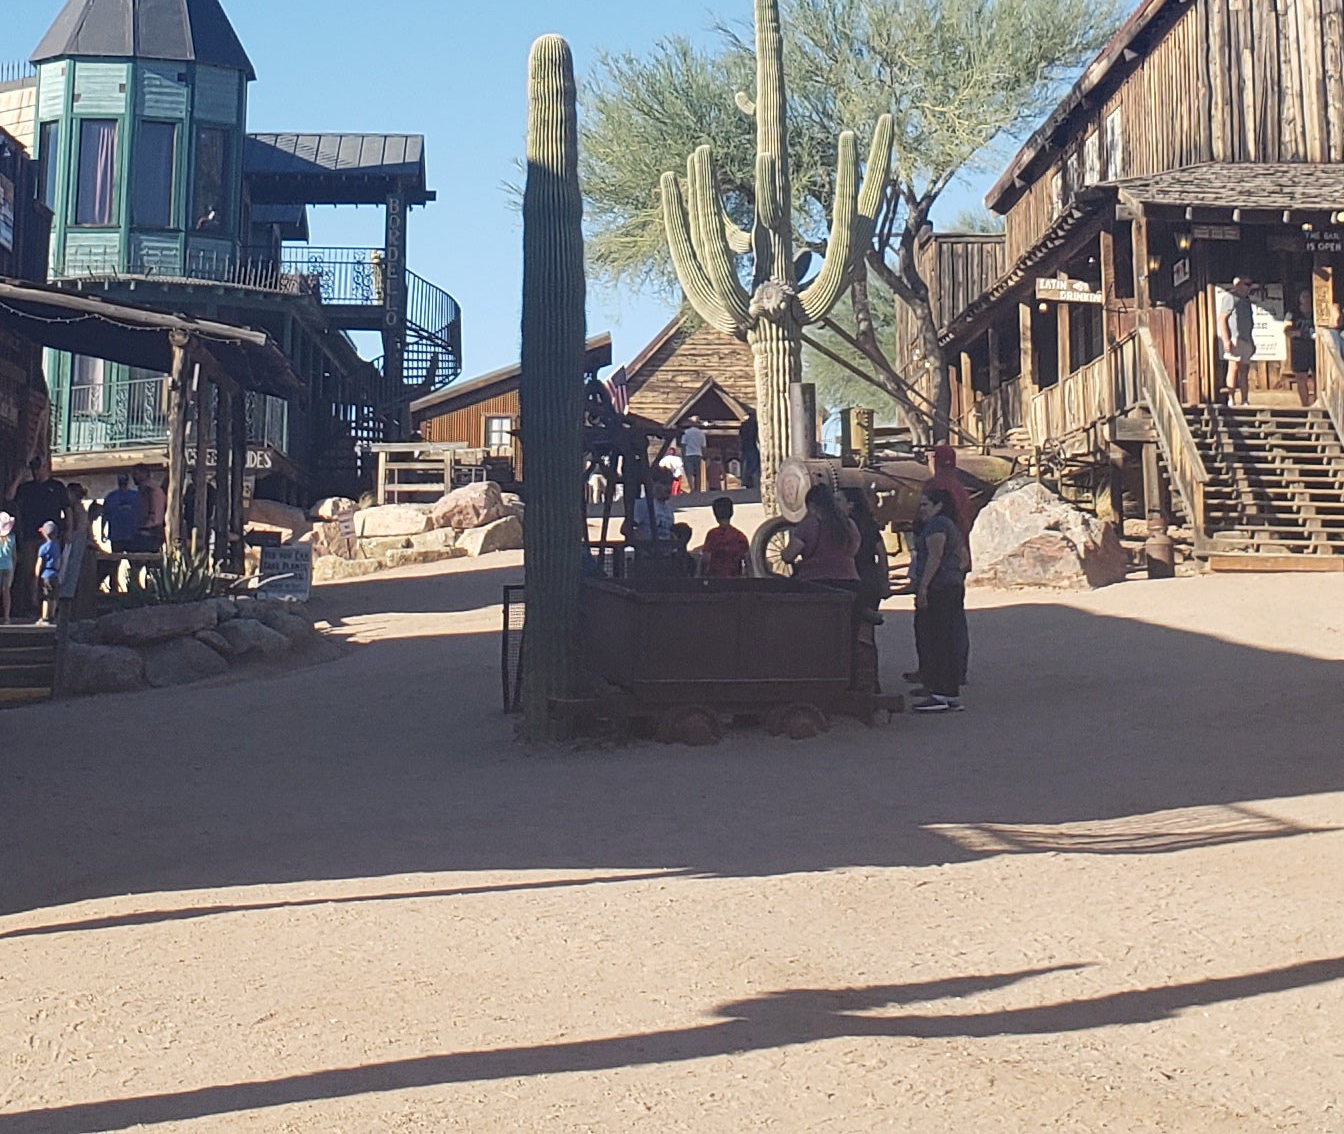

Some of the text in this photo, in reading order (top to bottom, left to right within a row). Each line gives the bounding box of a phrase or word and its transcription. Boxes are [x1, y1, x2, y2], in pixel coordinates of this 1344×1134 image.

[1304, 231, 1321, 240] THE
[1306, 242, 1342, 252] IS OPEN
[385, 197, 401, 326] BORDELLO
